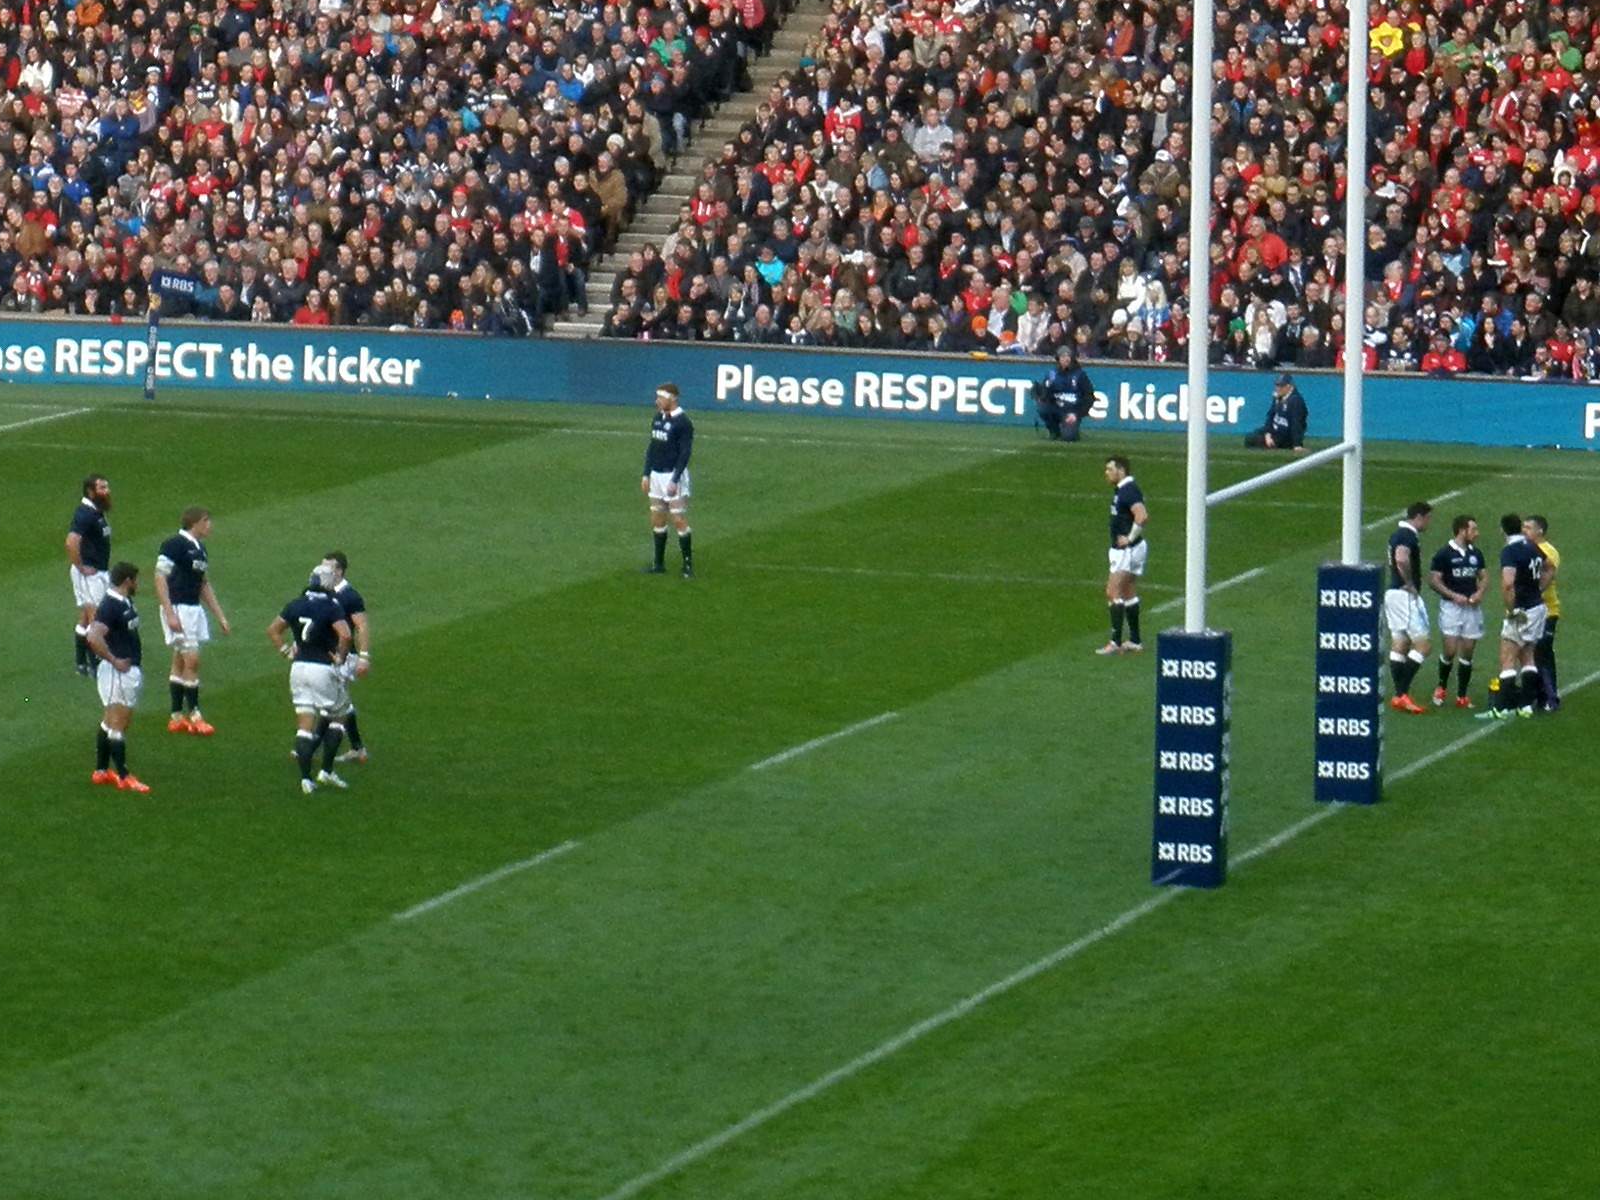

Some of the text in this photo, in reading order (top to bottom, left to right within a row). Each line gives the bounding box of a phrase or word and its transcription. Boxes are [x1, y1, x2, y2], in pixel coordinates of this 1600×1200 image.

[56, 339, 222, 380] RESPECT
[231, 344, 290, 381] the
[304, 346, 420, 386] kicker
[717, 364, 844, 405] Please
[855, 371, 1033, 415] RESPECT
[1338, 589, 1372, 608] RBS
[298, 617, 313, 642] 7
[1338, 633, 1372, 651] RBS
[1181, 660, 1217, 680] RBS
[1337, 676, 1371, 694] RBS
[1180, 706, 1216, 726] RBS
[1336, 718, 1370, 737] RBS
[1179, 752, 1215, 772] RBS
[1336, 761, 1370, 780] RBS
[1178, 797, 1214, 817] RBS
[1177, 843, 1213, 863] RBS
